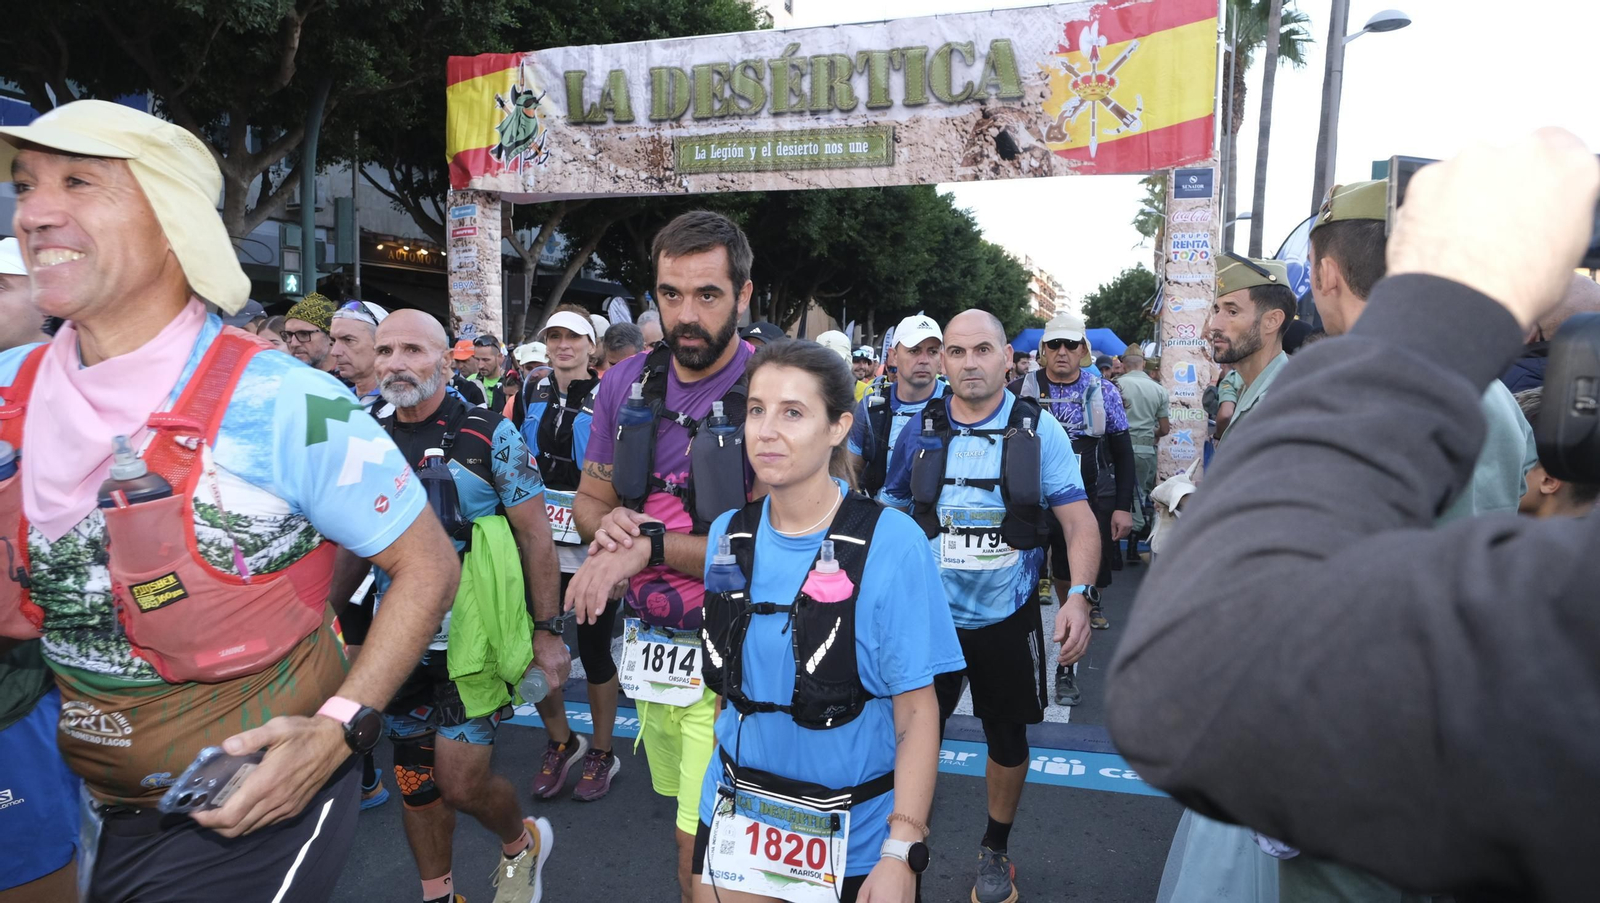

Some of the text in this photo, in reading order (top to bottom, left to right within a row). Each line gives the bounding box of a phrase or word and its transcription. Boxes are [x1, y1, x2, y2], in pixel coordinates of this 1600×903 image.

[564, 38, 1026, 124] LA DESÉRTICA
[695, 141, 869, 161] La Legión y el desierto nos une
[1172, 240, 1209, 249] RENTA
[452, 280, 474, 290] BBVA
[1167, 337, 1206, 347] primaflor
[965, 528, 1005, 548] 179
[642, 643, 696, 676] 1814
[669, 675, 690, 684] CHISPAS
[102, 737, 132, 747] LAGOS
[737, 795, 753, 810] LA
[760, 801, 831, 829] DESÉRTIC
[745, 821, 827, 871] 1820
[708, 868, 737, 882] asisa
[790, 868, 822, 880] MARISOL
